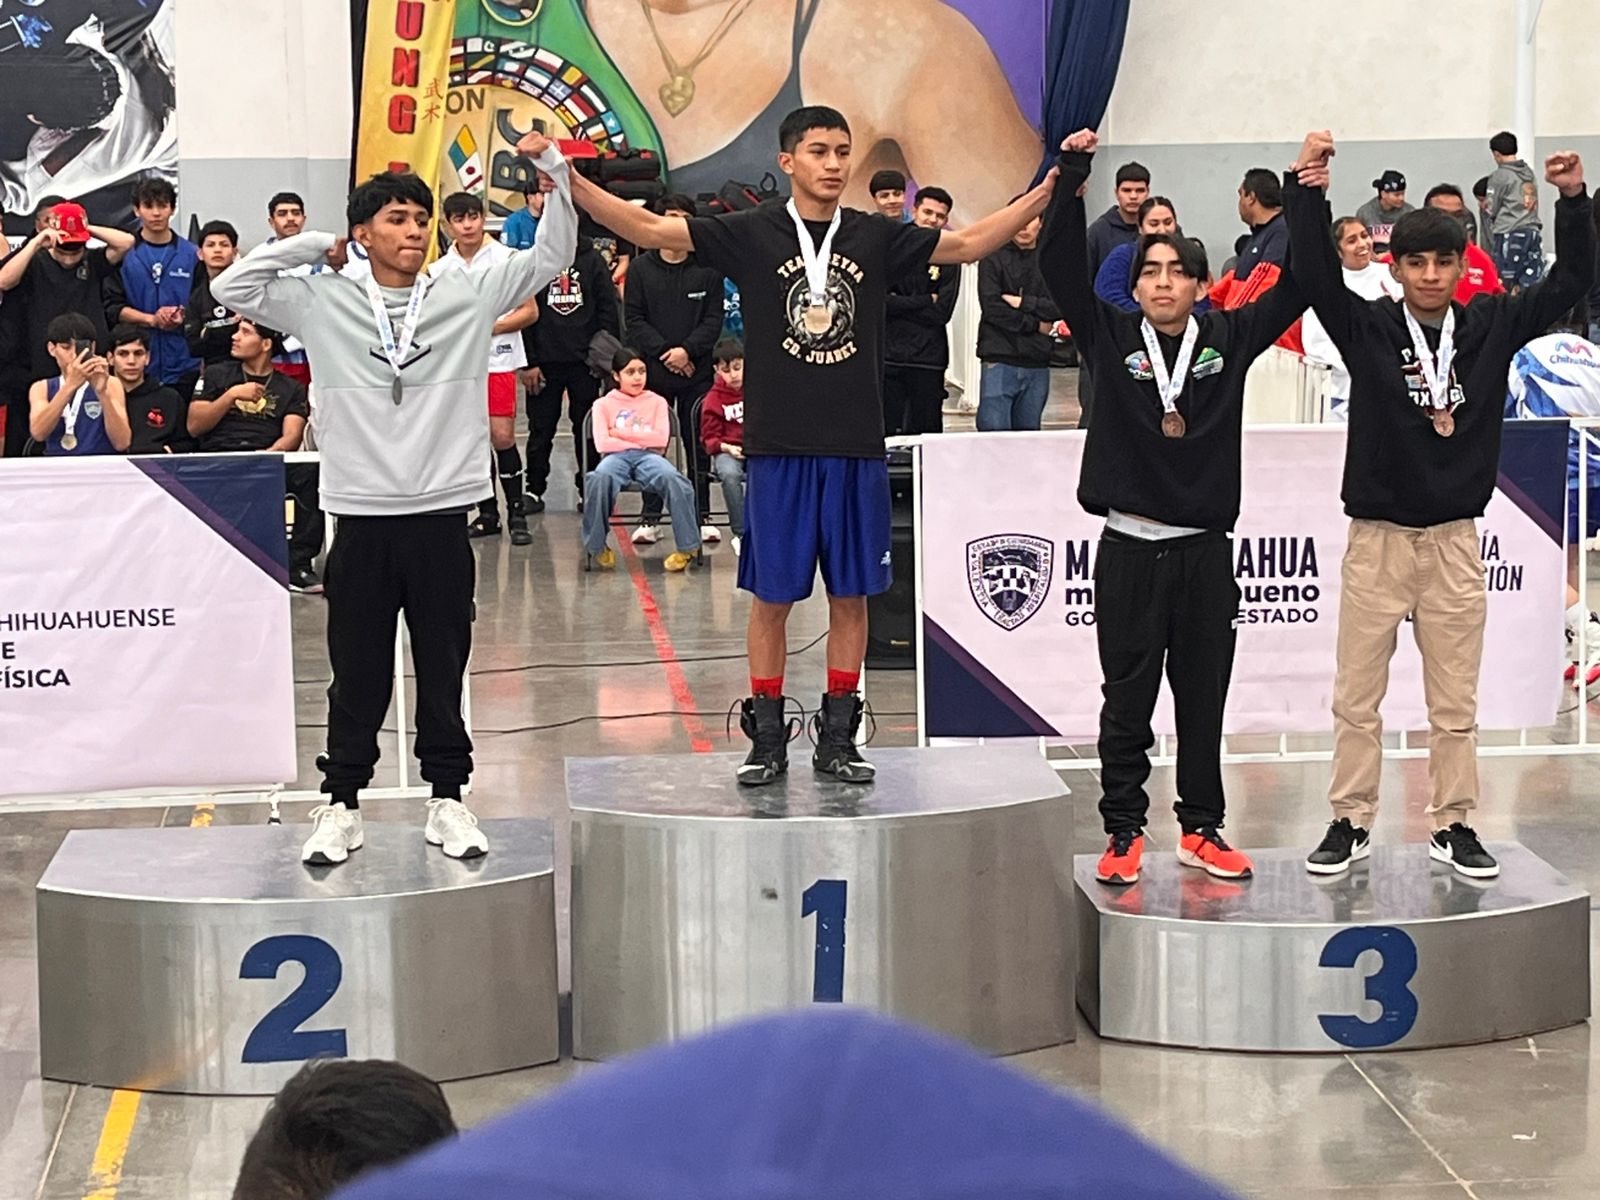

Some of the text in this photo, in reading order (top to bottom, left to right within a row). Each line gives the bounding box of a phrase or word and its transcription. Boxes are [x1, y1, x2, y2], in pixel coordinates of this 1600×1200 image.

[777, 253, 865, 284] TEA EYRA
[1244, 585, 1320, 603] ueno
[240, 934, 348, 1062] 2
[801, 879, 847, 1001] 1
[1319, 927, 1419, 1047] 3
